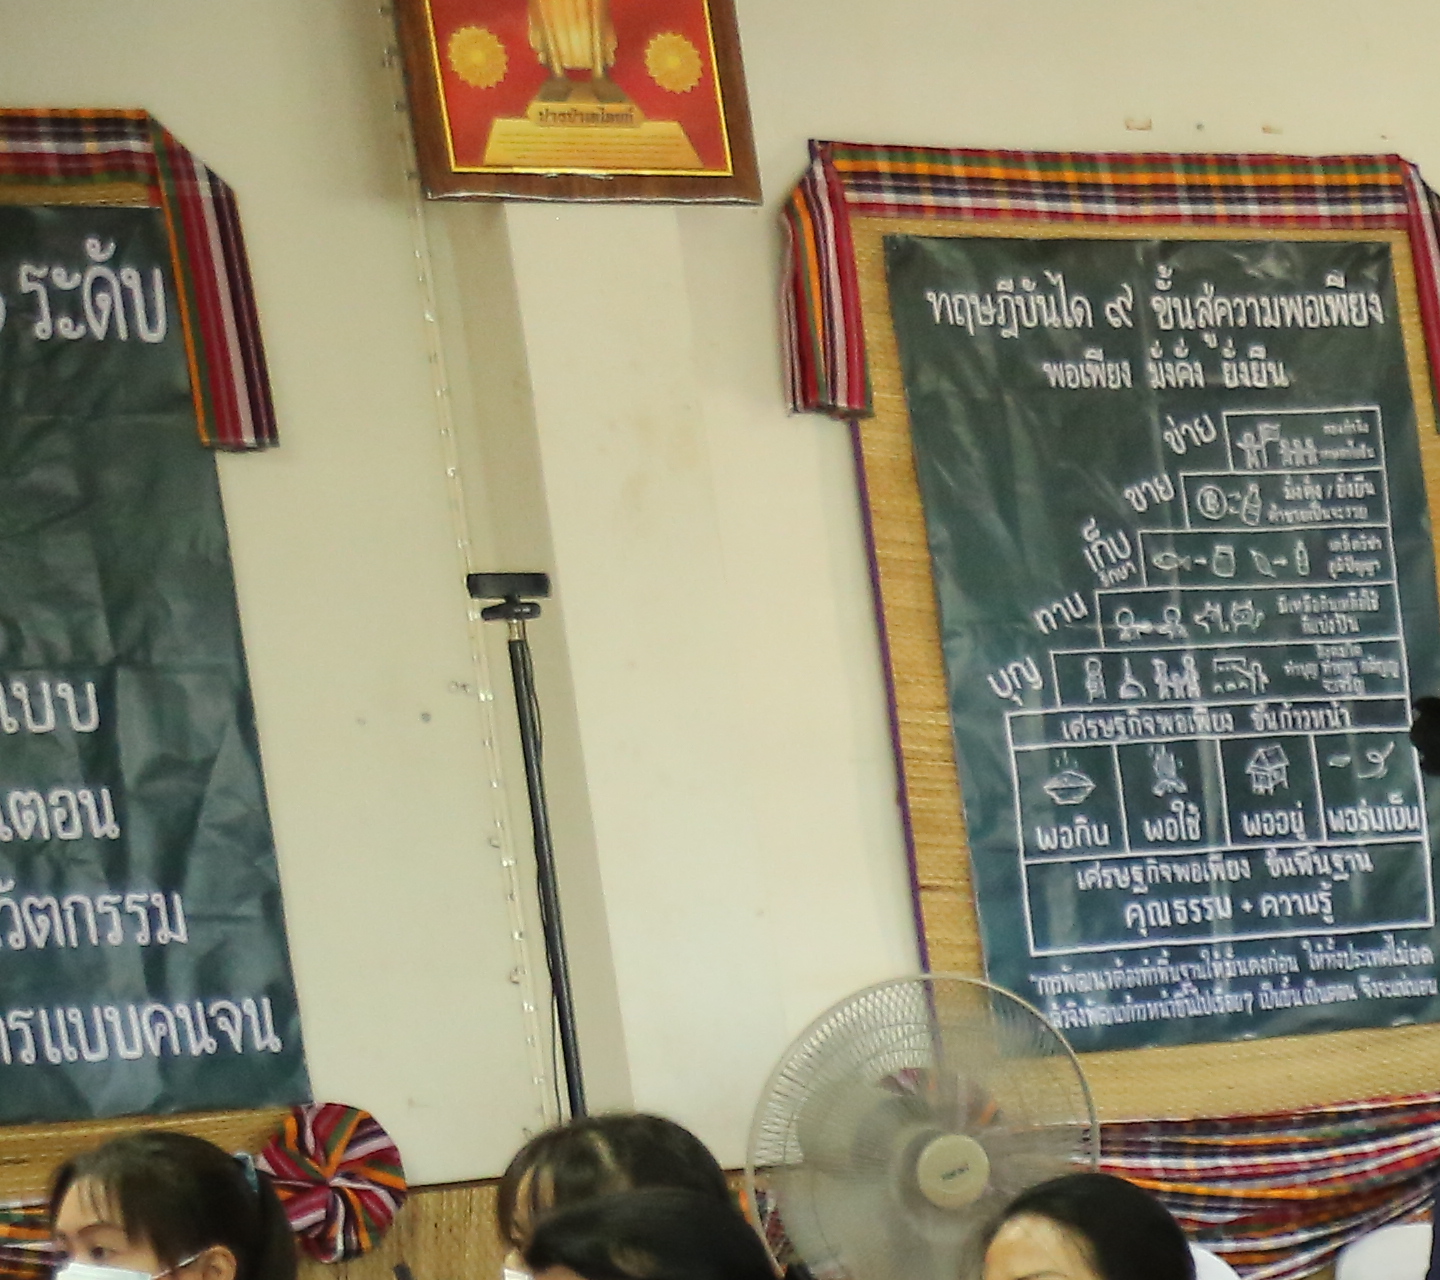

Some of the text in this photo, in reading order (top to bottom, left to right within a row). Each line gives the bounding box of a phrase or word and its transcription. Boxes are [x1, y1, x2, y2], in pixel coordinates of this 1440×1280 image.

[19, 232, 168, 344] ระดับ
[1103, 282, 1134, 329] ๙
[1151, 263, 1386, 349] ขั้นสู่ความพอเพียง
[1042, 338, 1291, 390] พอเพียง มั่งคั่ง ยั่งยืน
[1124, 473, 1175, 512] ขาย
[1081, 516, 1132, 573] เก็บ
[1033, 591, 1088, 635] ทาน
[987, 654, 1044, 707] บุญ
[1062, 706, 1235, 742] เศรษฐกิจพอเพียง
[1035, 814, 1111, 851] พอกิน
[1143, 799, 1201, 842] พอใช้
[1242, 800, 1307, 842] พออยู่
[1076, 853, 1252, 894] เศรษฐกิจพอเพียง
[1124, 893, 1234, 938] คุณธรรม
[1259, 880, 1335, 924] ความรู้
